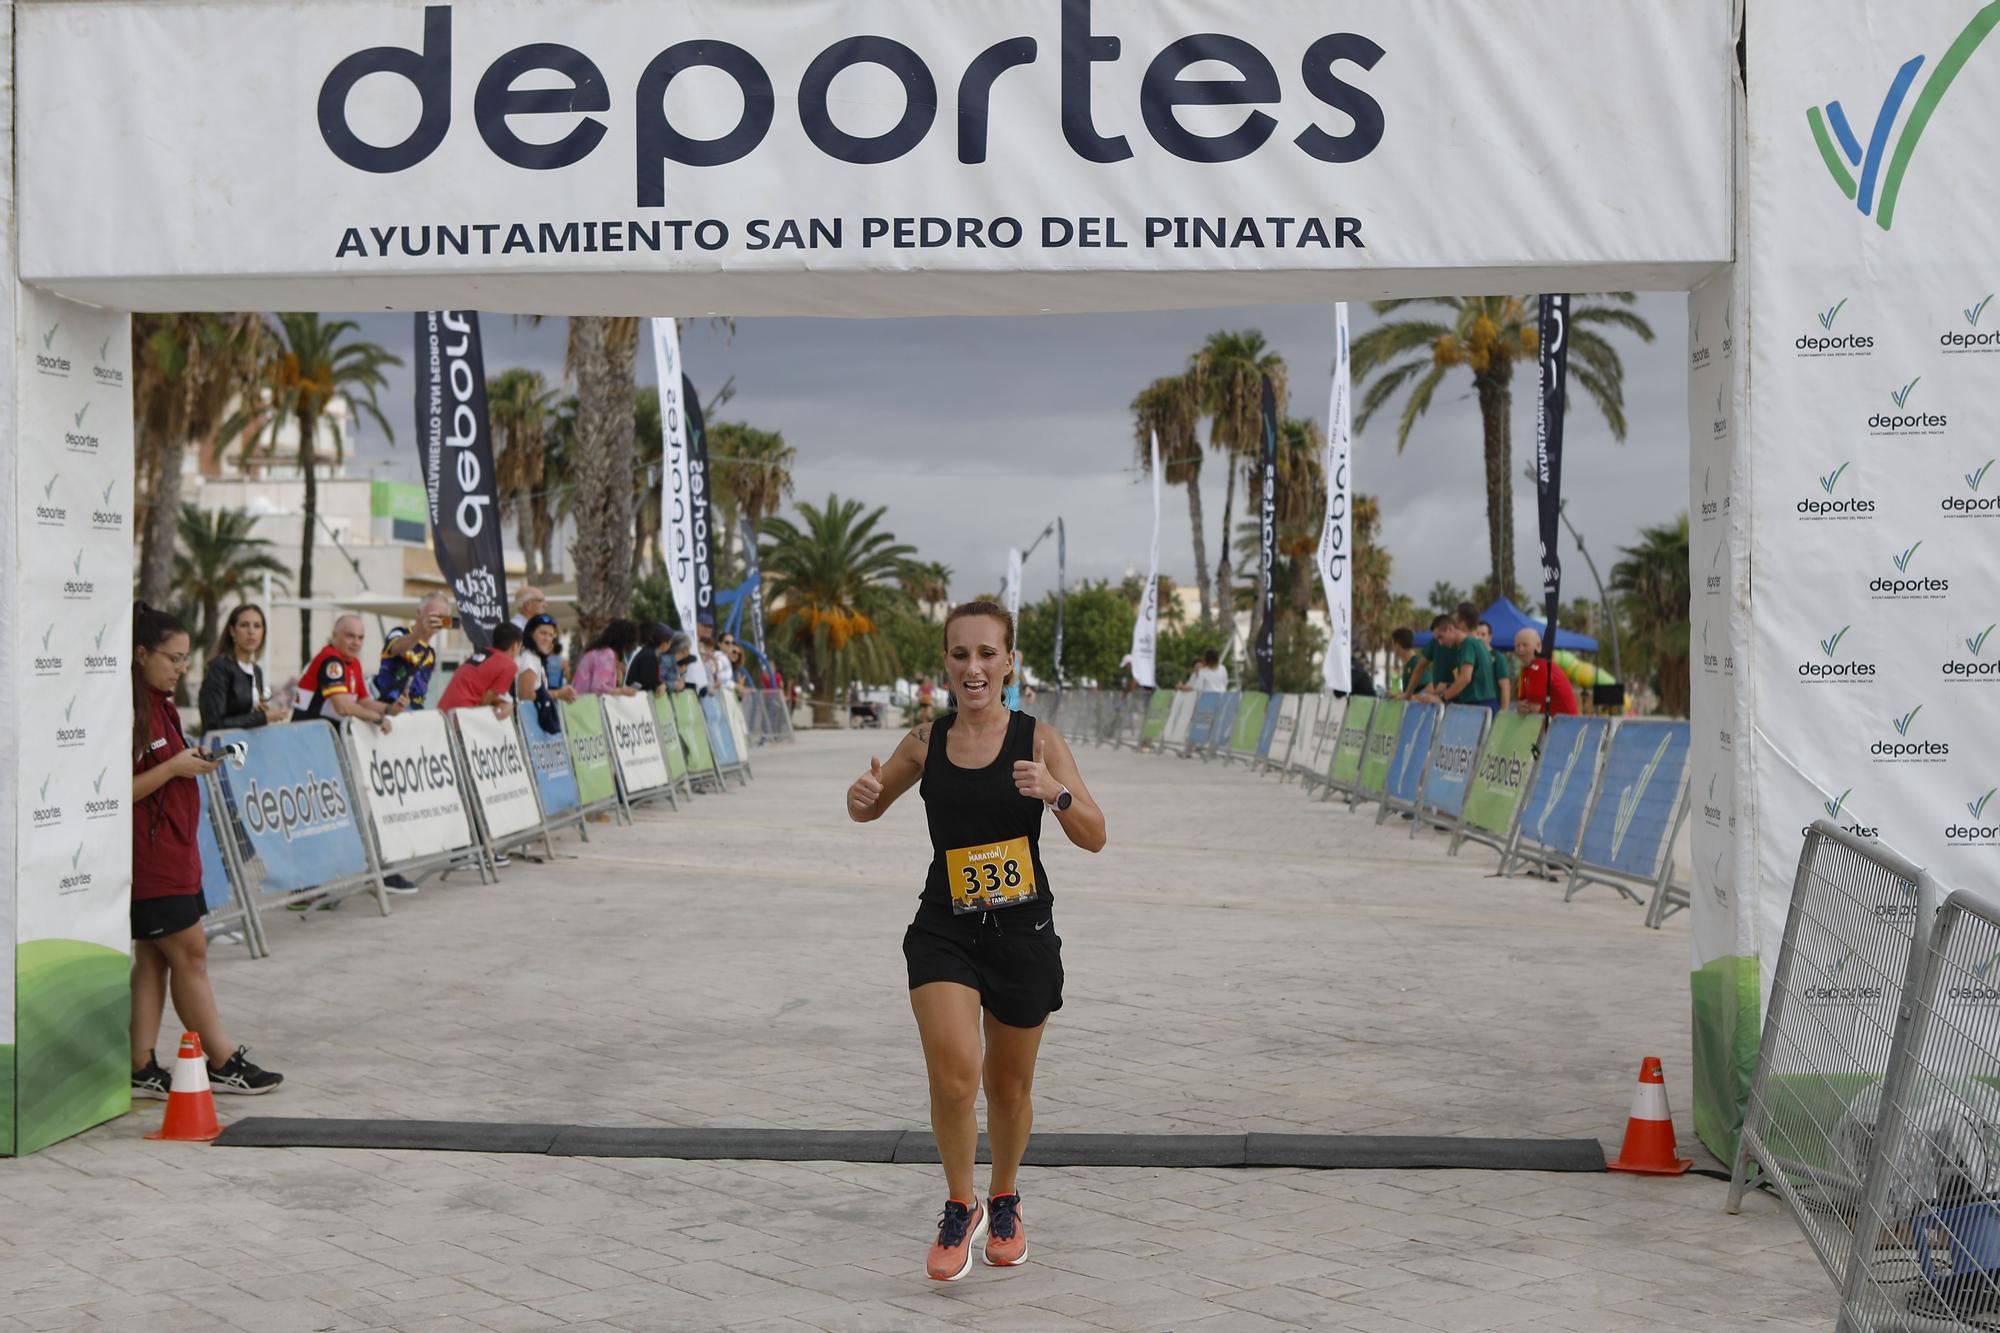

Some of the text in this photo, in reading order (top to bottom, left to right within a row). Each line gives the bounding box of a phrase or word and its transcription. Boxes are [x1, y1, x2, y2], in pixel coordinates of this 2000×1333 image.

[317, 0, 1386, 207] deportes
[336, 216, 1366, 258] AYUNTAMIENTO SAN PEDRO DEL PINATAR
[1795, 334, 1874, 352] deportes
[1868, 412, 1947, 430] deportes
[65, 432, 99, 449] deportes
[1796, 497, 1875, 516] deportes
[1869, 577, 1948, 594] deportes
[1798, 661, 1876, 679] deportes
[615, 715, 656, 756] deportes
[1870, 740, 1949, 758] deportes
[471, 735, 522, 789] deportes
[370, 745, 454, 806] deportes
[244, 770, 347, 842] deportes
[1945, 824, 2000, 841] depor
[962, 858, 1022, 895] 338
